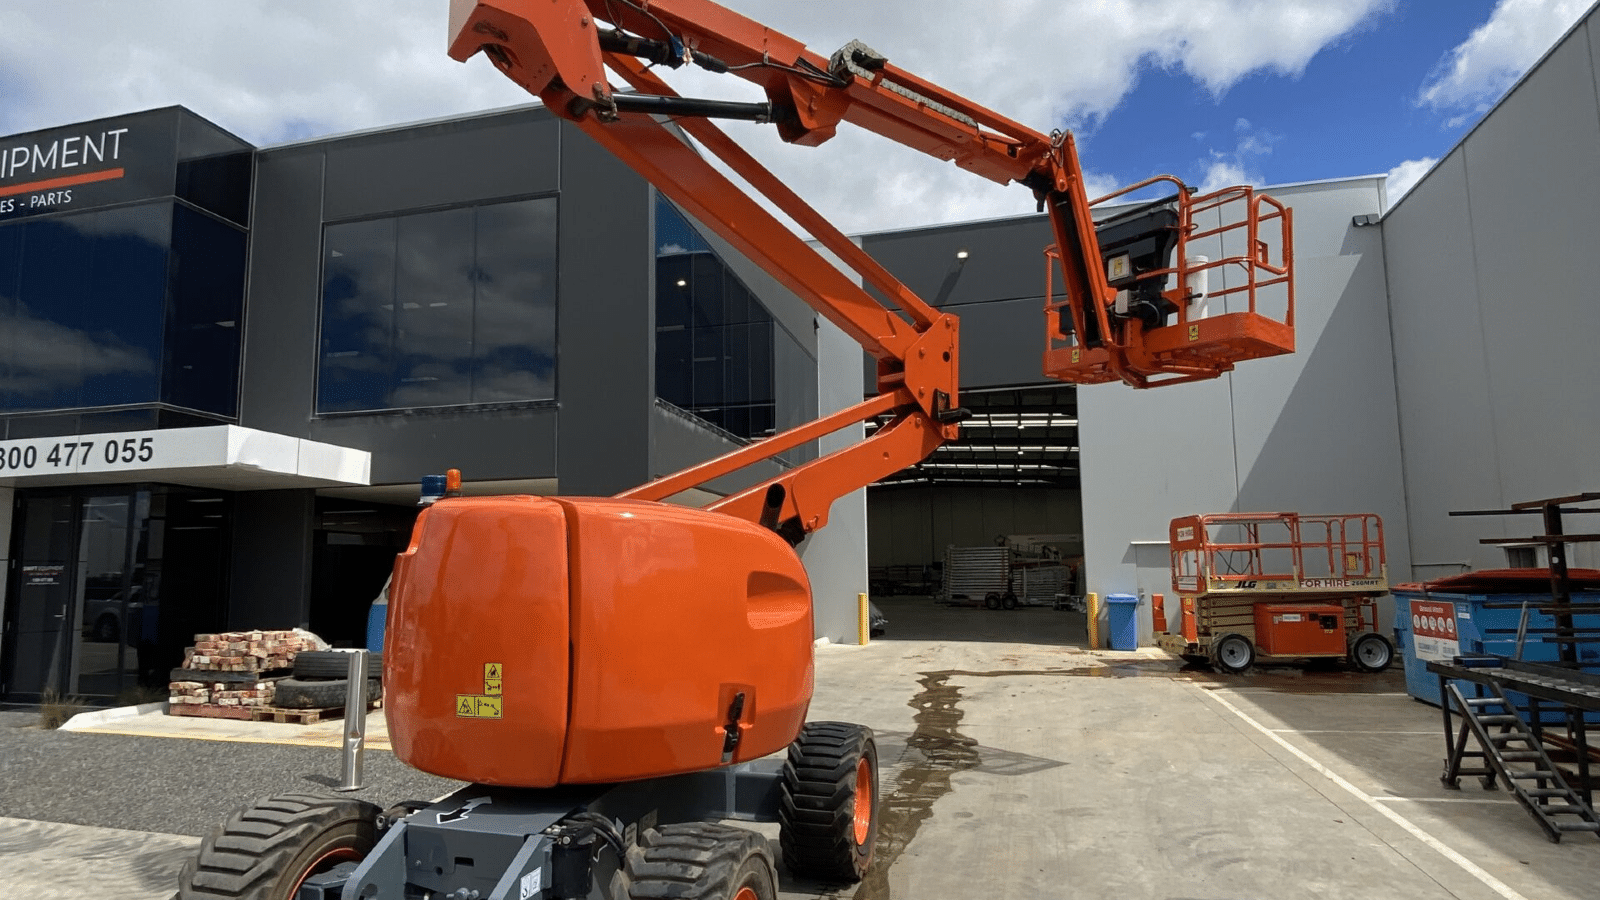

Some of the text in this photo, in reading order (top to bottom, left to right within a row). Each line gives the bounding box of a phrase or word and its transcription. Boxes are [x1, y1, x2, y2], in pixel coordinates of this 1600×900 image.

[1, 128, 128, 178] IPMENT
[0, 199, 15, 213] ES
[30, 190, 72, 208] PARTS
[47, 441, 94, 467] 477
[105, 437, 153, 464] 055
[1235, 580, 1257, 588] JLG
[1300, 579, 1350, 587] FOR HIRE
